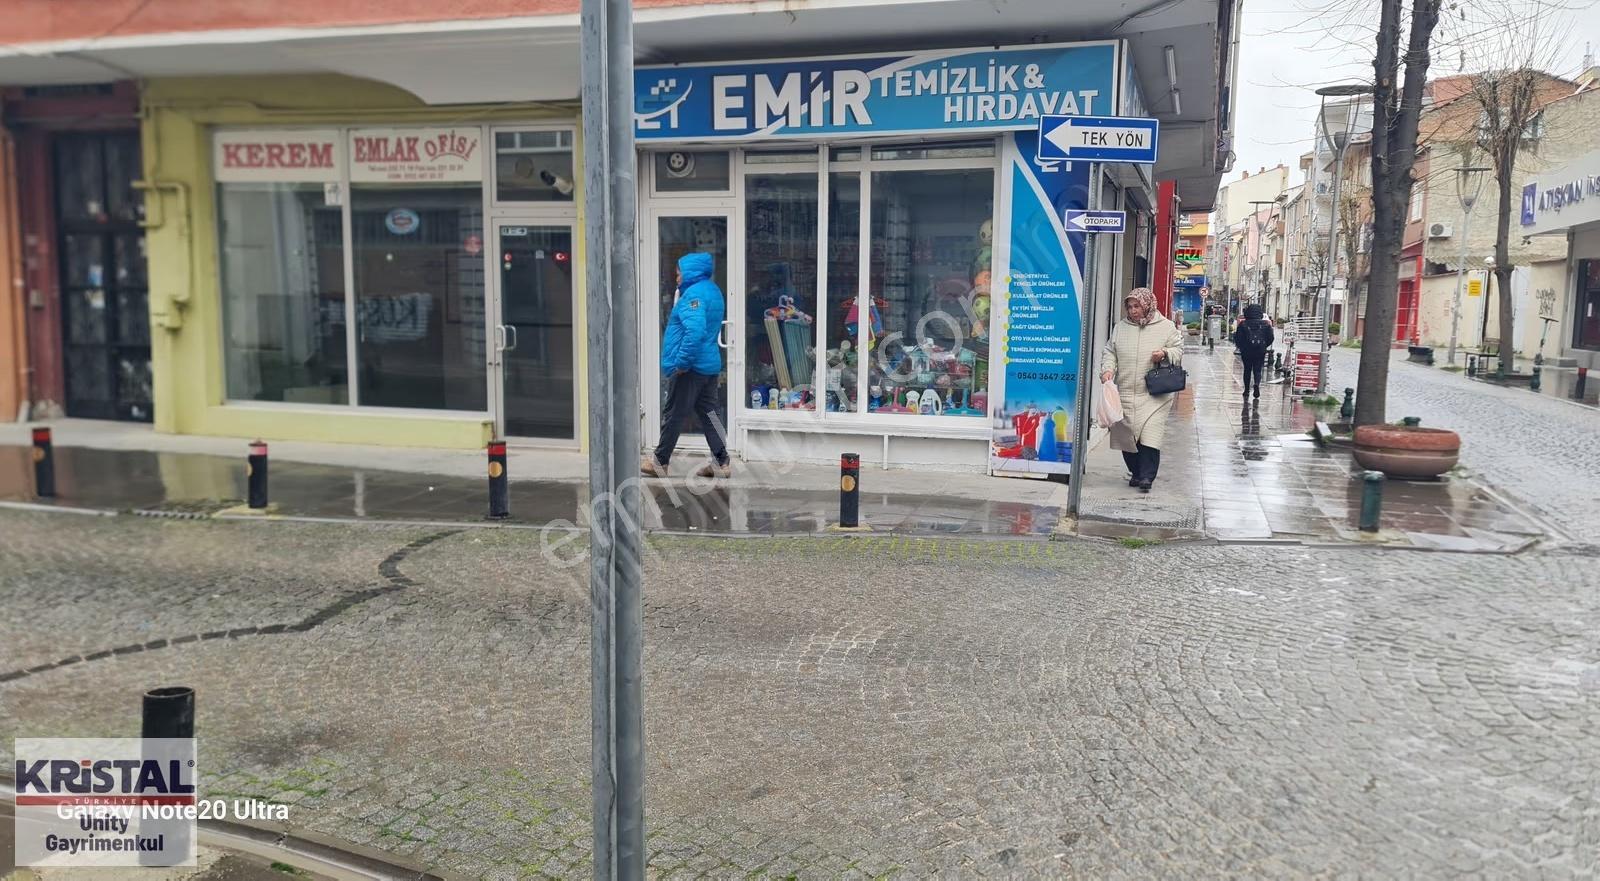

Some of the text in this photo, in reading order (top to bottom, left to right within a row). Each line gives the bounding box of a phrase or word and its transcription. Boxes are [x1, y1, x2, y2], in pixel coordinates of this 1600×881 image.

[880, 58, 1045, 97] TEMİZLİK &
[944, 89, 1099, 123] HIRDAVAT
[353, 136, 421, 162] EMLAK
[1082, 131, 1143, 147] TEK YÖN
[222, 143, 334, 168] KEREM
[1083, 217, 1119, 226] OTOPARK
[1017, 372, 1037, 380] 0540
